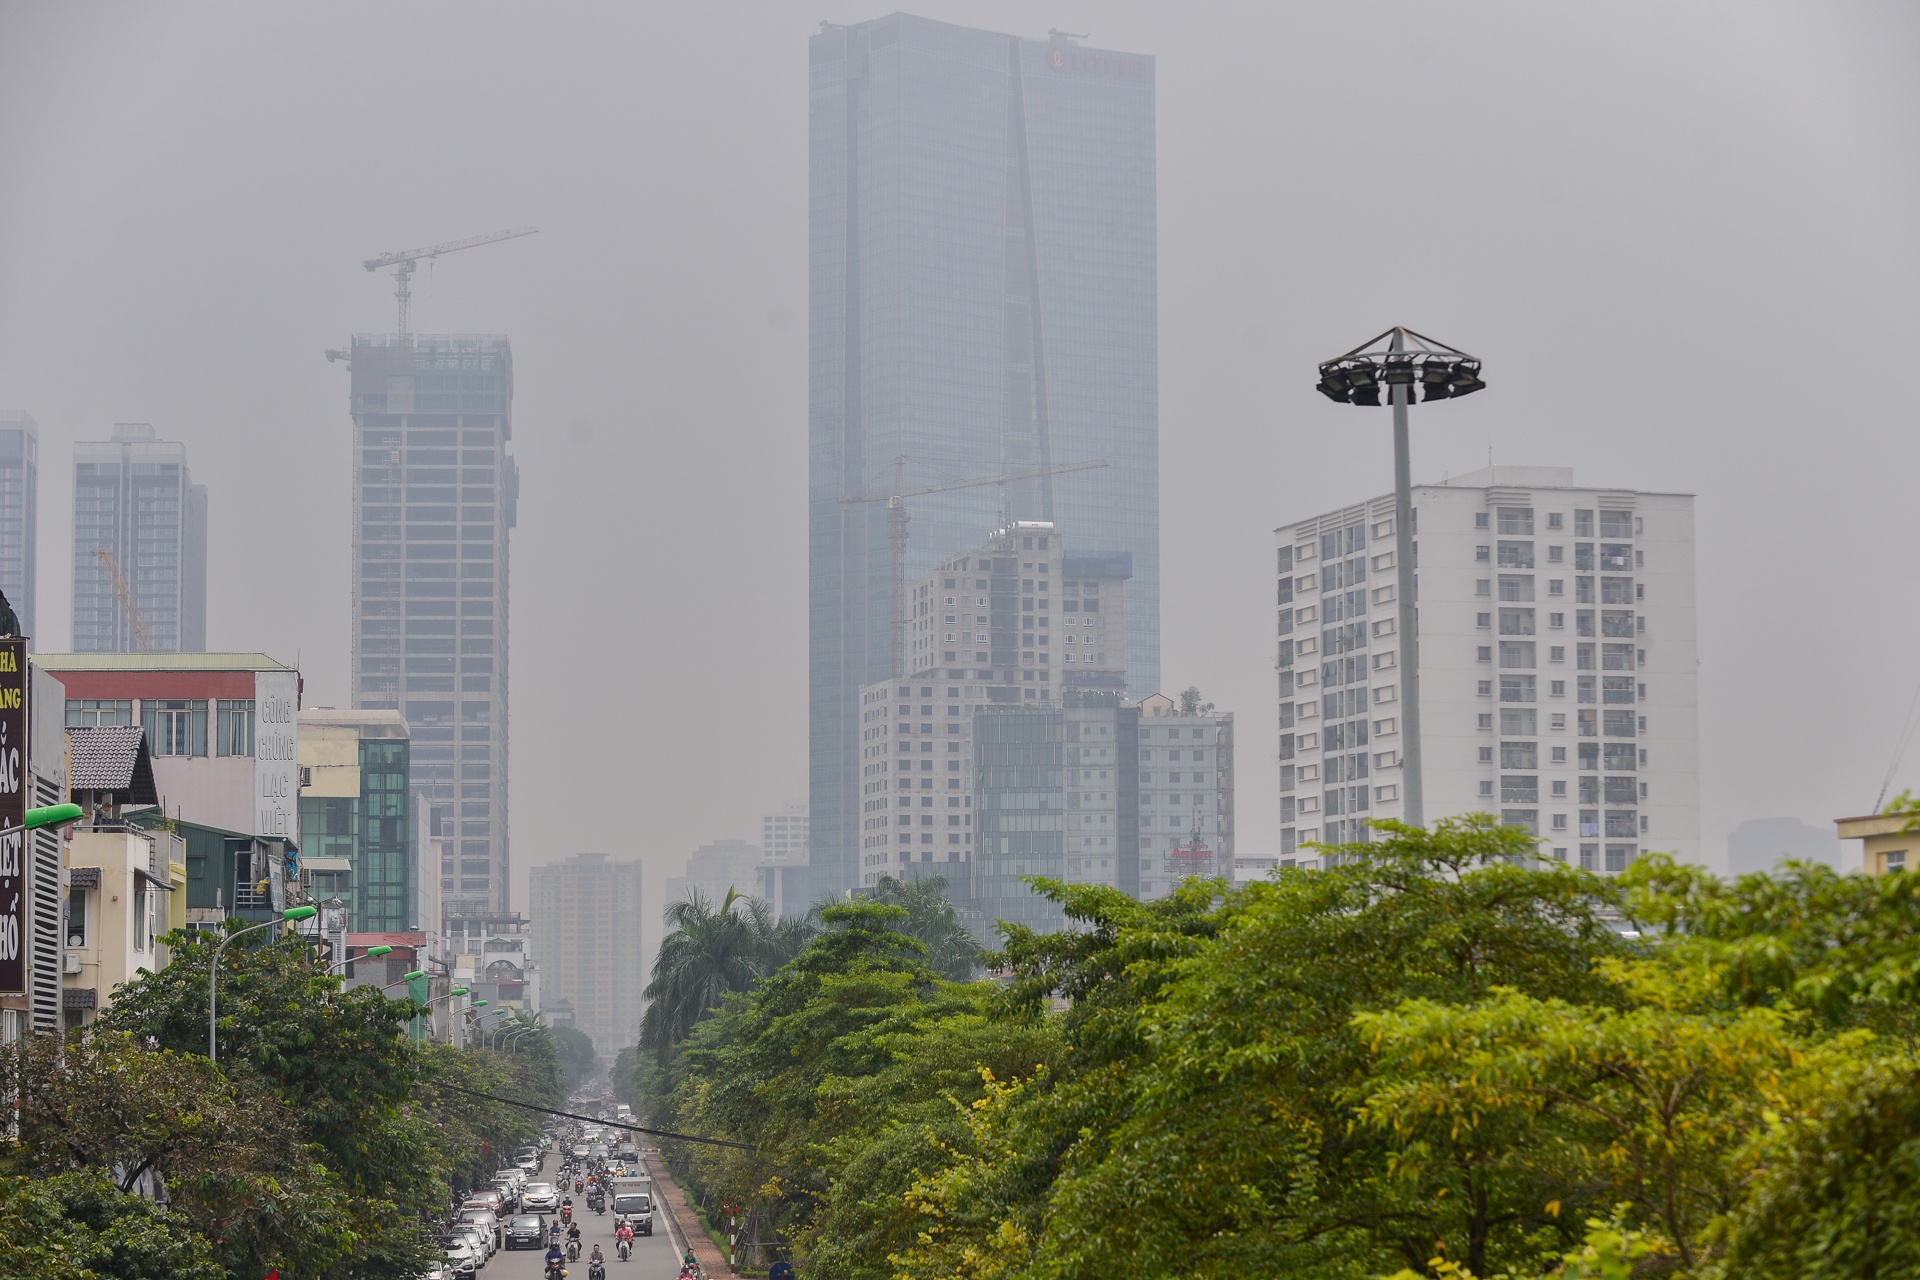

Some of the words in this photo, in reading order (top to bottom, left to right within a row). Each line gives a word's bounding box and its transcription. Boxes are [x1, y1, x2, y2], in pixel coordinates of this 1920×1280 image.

[1072, 54, 1145, 78] LOTTE
[262, 695, 291, 724] CÔNG
[258, 728, 294, 761] CHỨNG
[263, 773, 289, 803] LẠC
